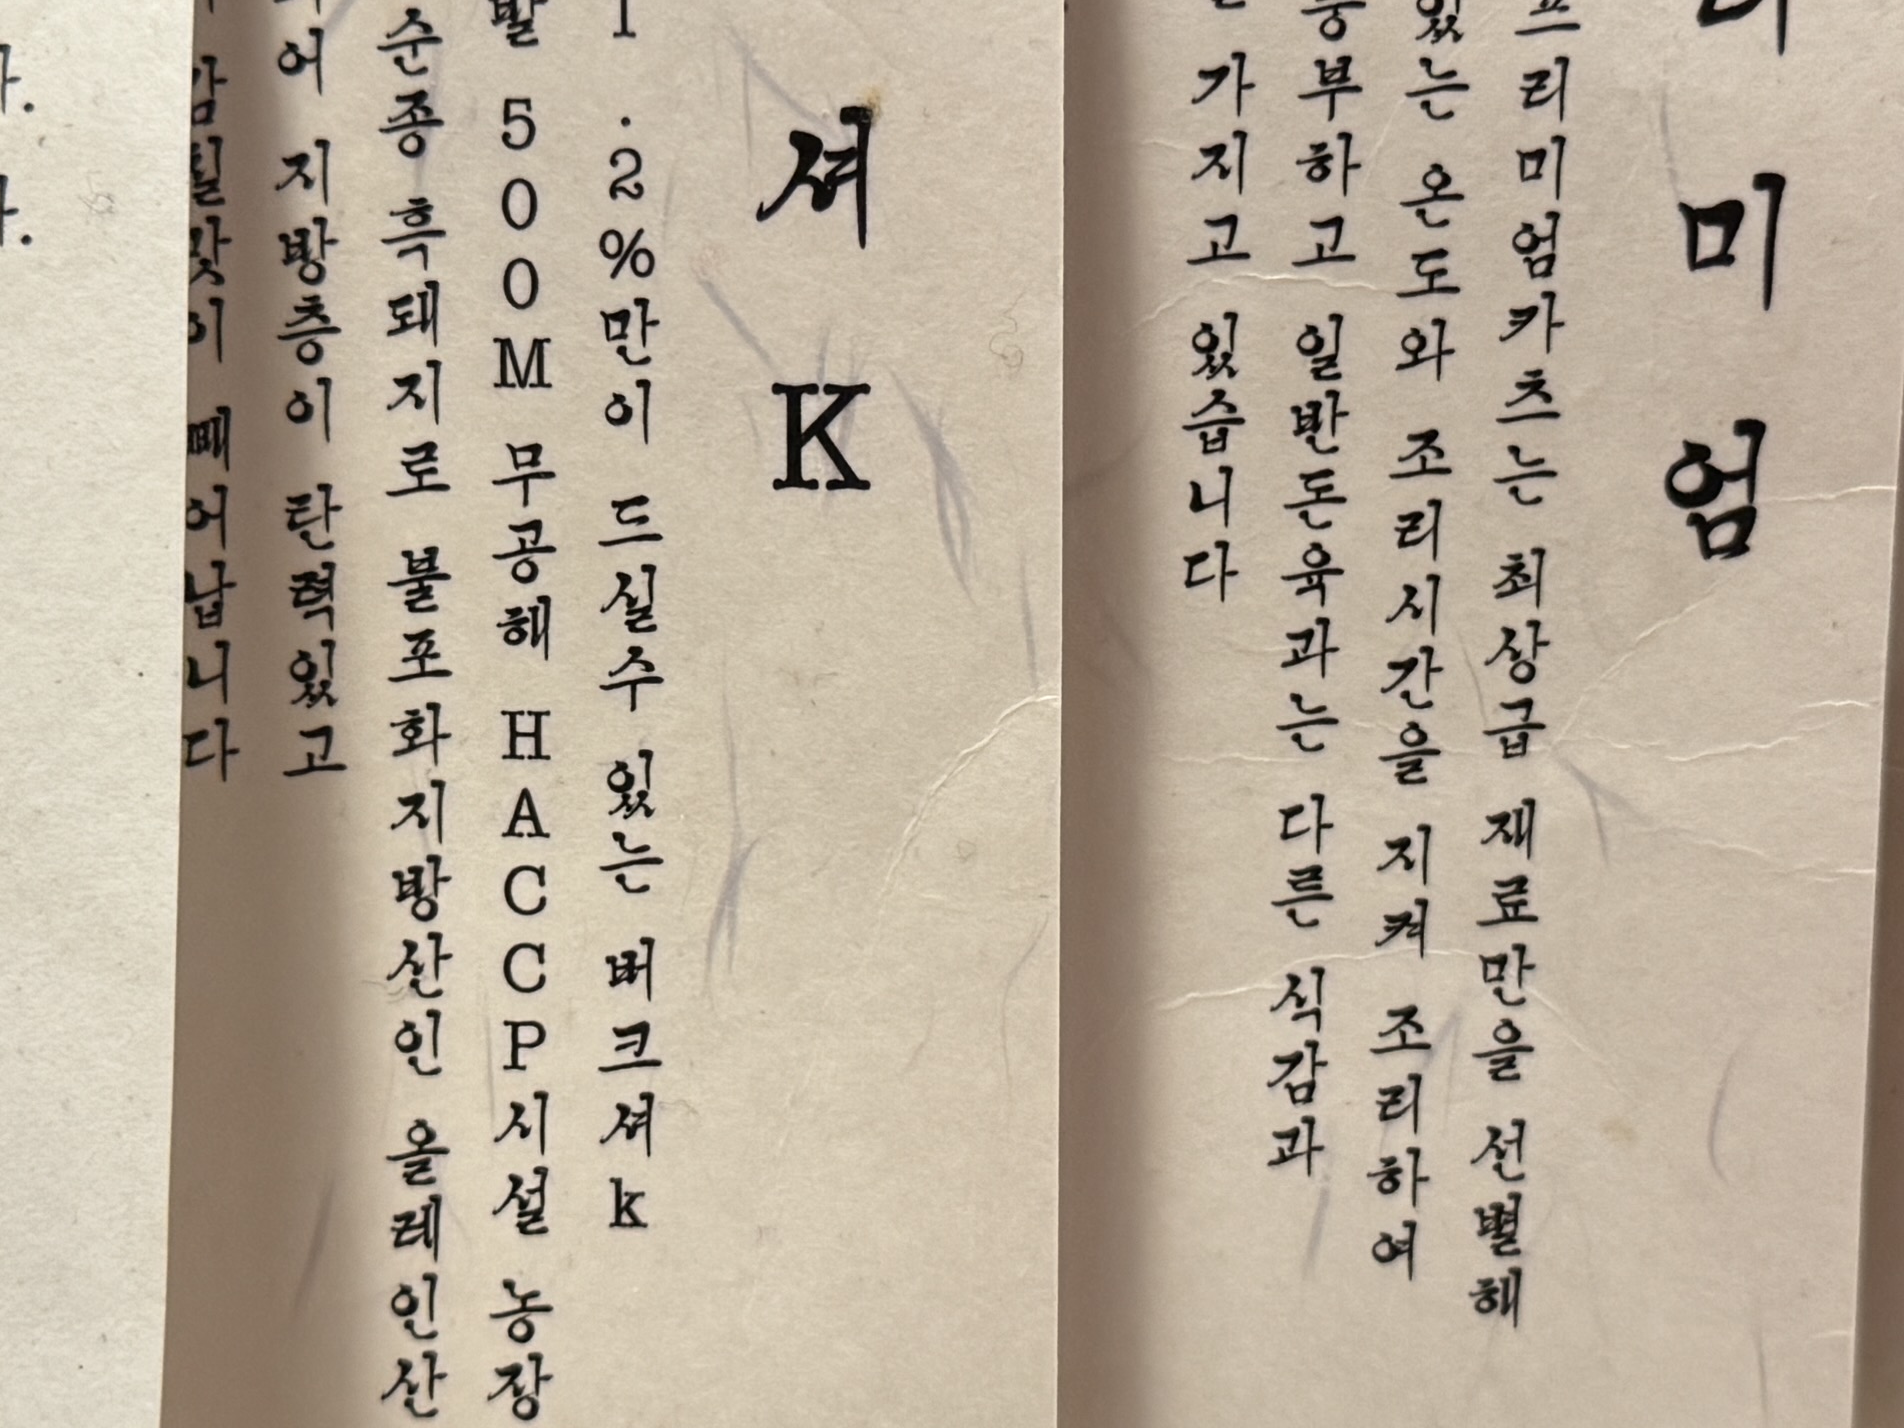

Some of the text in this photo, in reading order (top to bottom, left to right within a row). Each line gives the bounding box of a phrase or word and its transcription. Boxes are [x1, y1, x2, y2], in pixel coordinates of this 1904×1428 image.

[376, 7, 445, 160] 순종
[1186, 51, 1256, 266] 가지고
[275, 138, 342, 443] 지방층이
[380, 196, 451, 497] 흑돼지로
[493, 97, 553, 389] 500M
[1395, 162, 1465, 382] 온도와
[181, 404, 244, 786] 빼어납니다
[491, 442, 557, 661] 무공해
[1182, 311, 1246, 603] 있습니다
[1276, 313, 1350, 753] 일반돈육과는
[283, 483, 347, 777] 탄력있고
[598, 494, 664, 712] 드실수
[1378, 428, 1453, 786] 조리시간을
[1482, 546, 1551, 760] 최상급
[386, 546, 453, 1077] 불포화지방산인
[599, 749, 664, 894] 있는
[1271, 793, 1334, 929] 다른
[1374, 823, 1432, 959] 지켜
[1472, 797, 1539, 1083] 재료만을
[492, 710, 551, 1237] HACCP시설
[598, 936, 663, 1229] 버크셔k
[1267, 966, 1328, 1177] 식감과
[1366, 1004, 1433, 1281] 조리하여
[1468, 1118, 1526, 1329] 선별해
